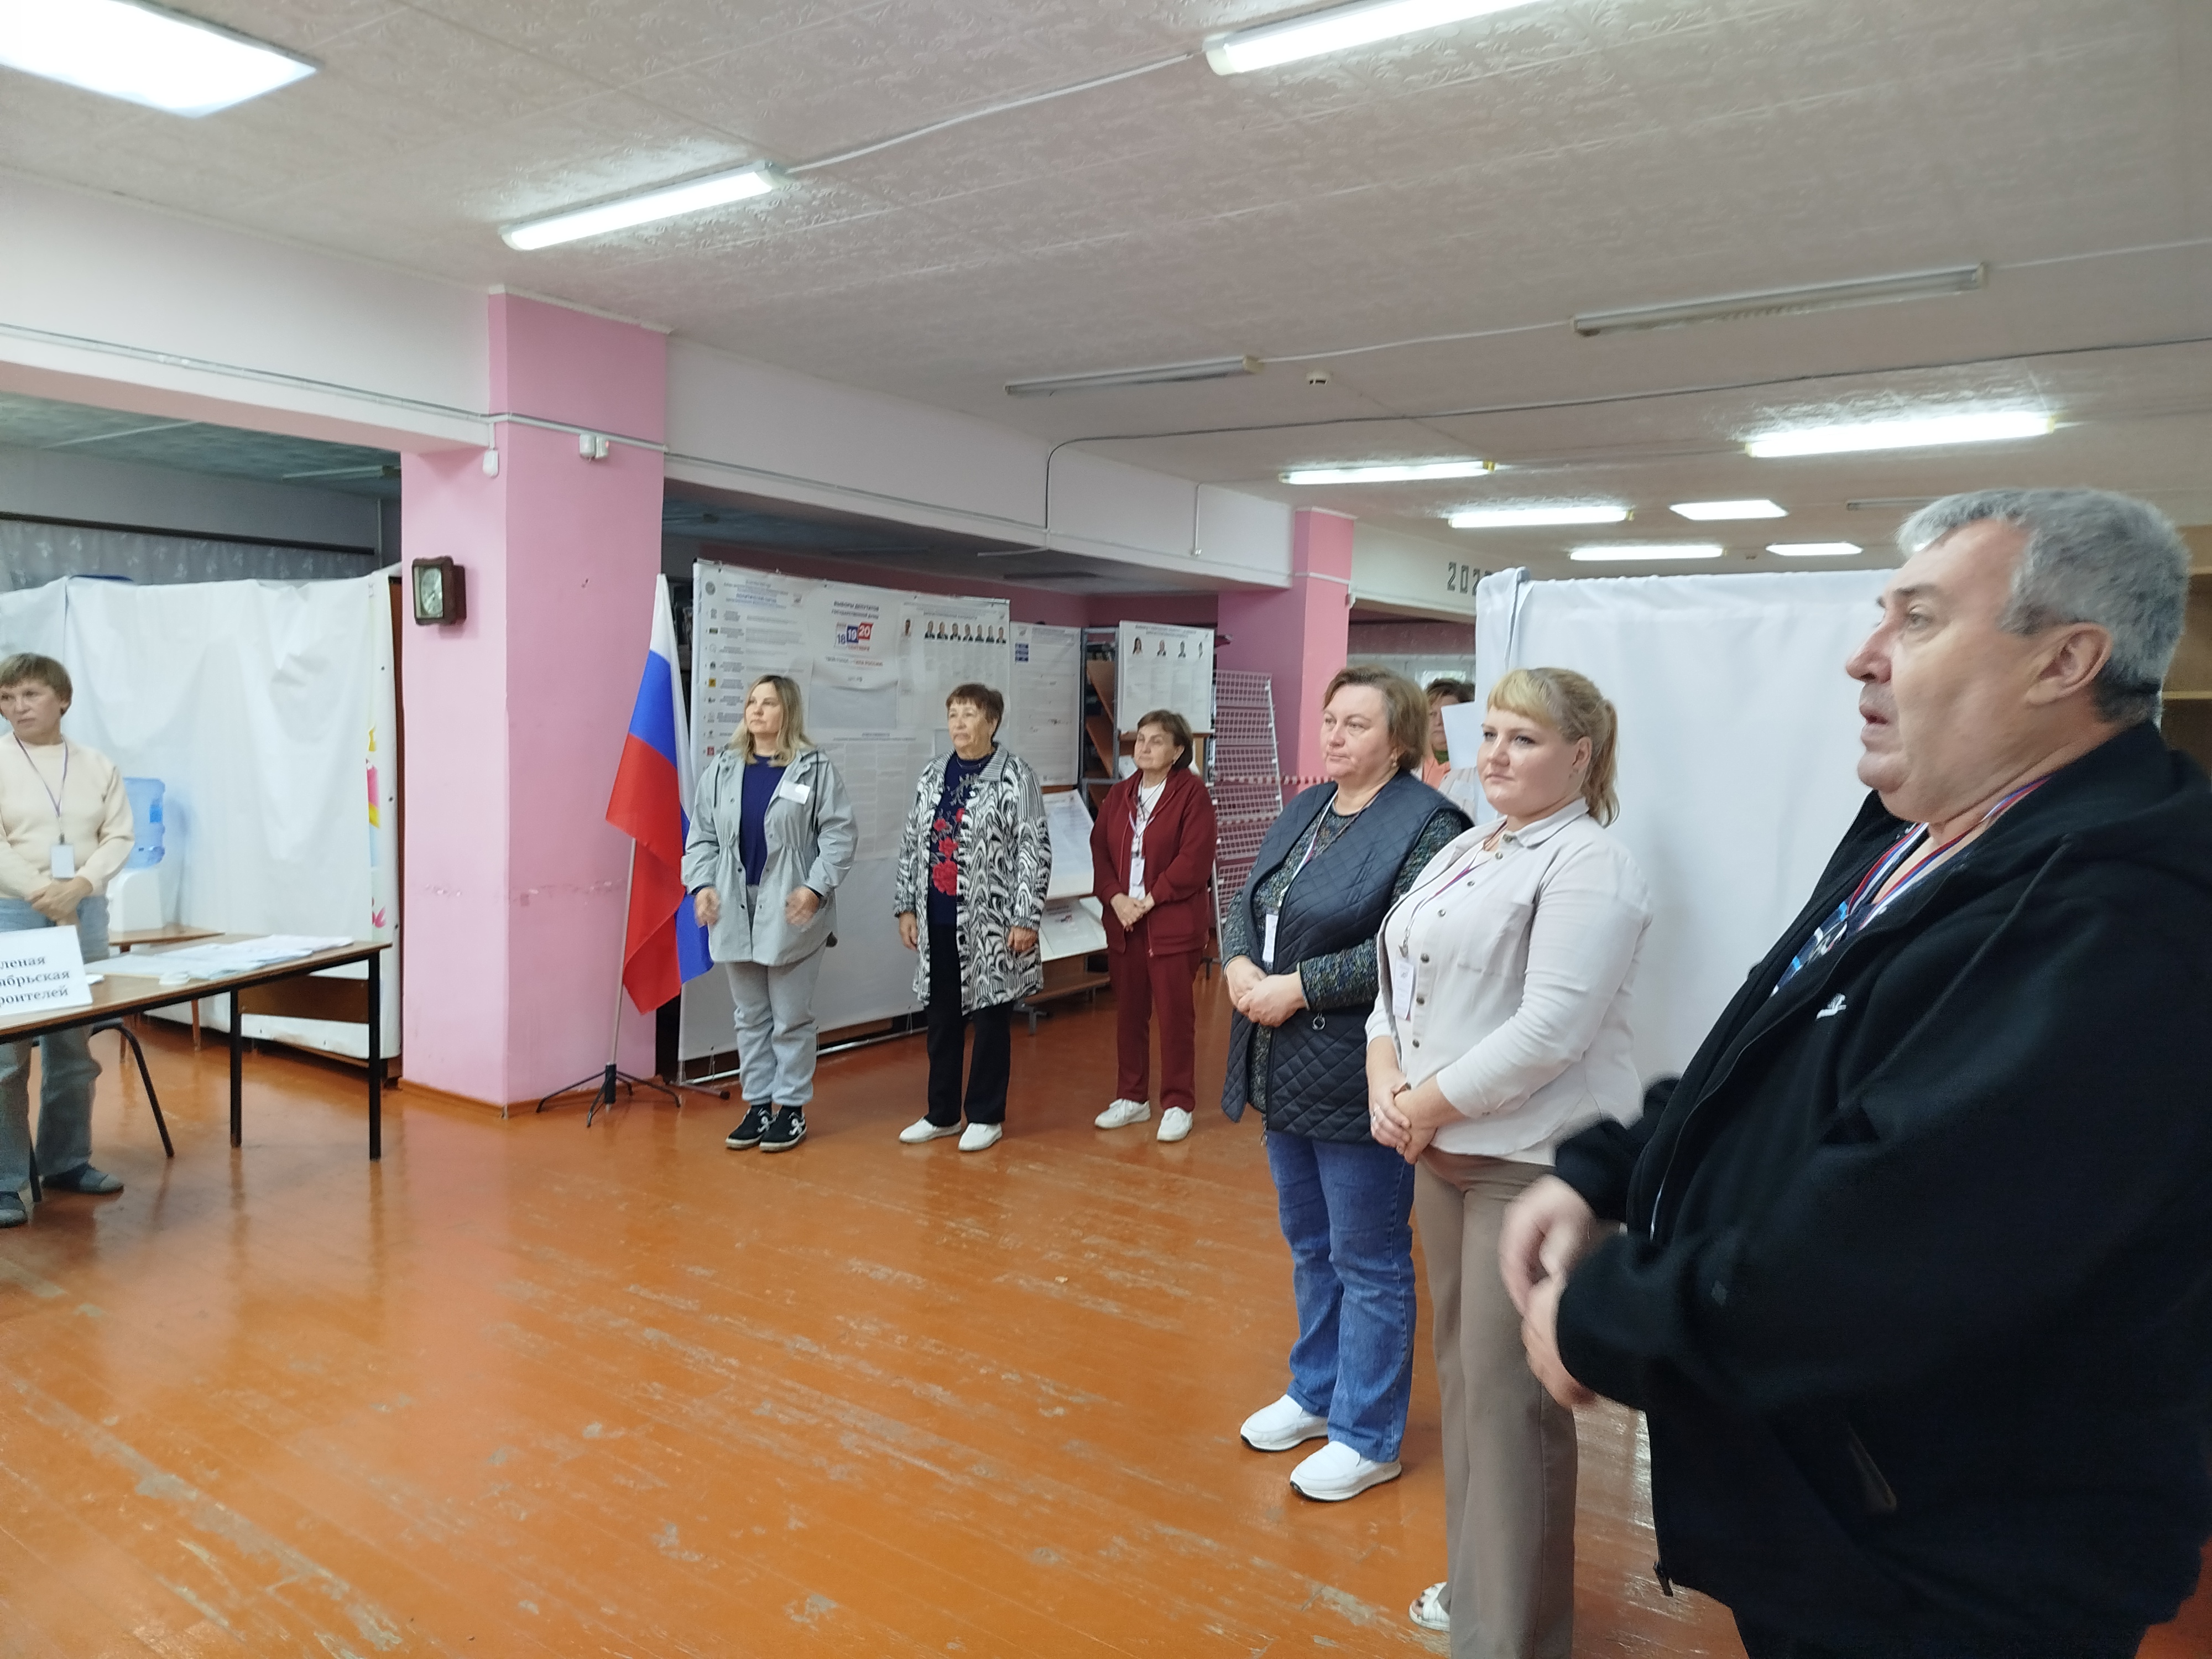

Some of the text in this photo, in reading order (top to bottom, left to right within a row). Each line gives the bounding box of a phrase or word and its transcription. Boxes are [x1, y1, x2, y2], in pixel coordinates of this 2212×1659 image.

[1447, 561, 1493, 596] 202
[837, 625, 871, 644] 18 19 20
[1, 956, 45, 969] леная
